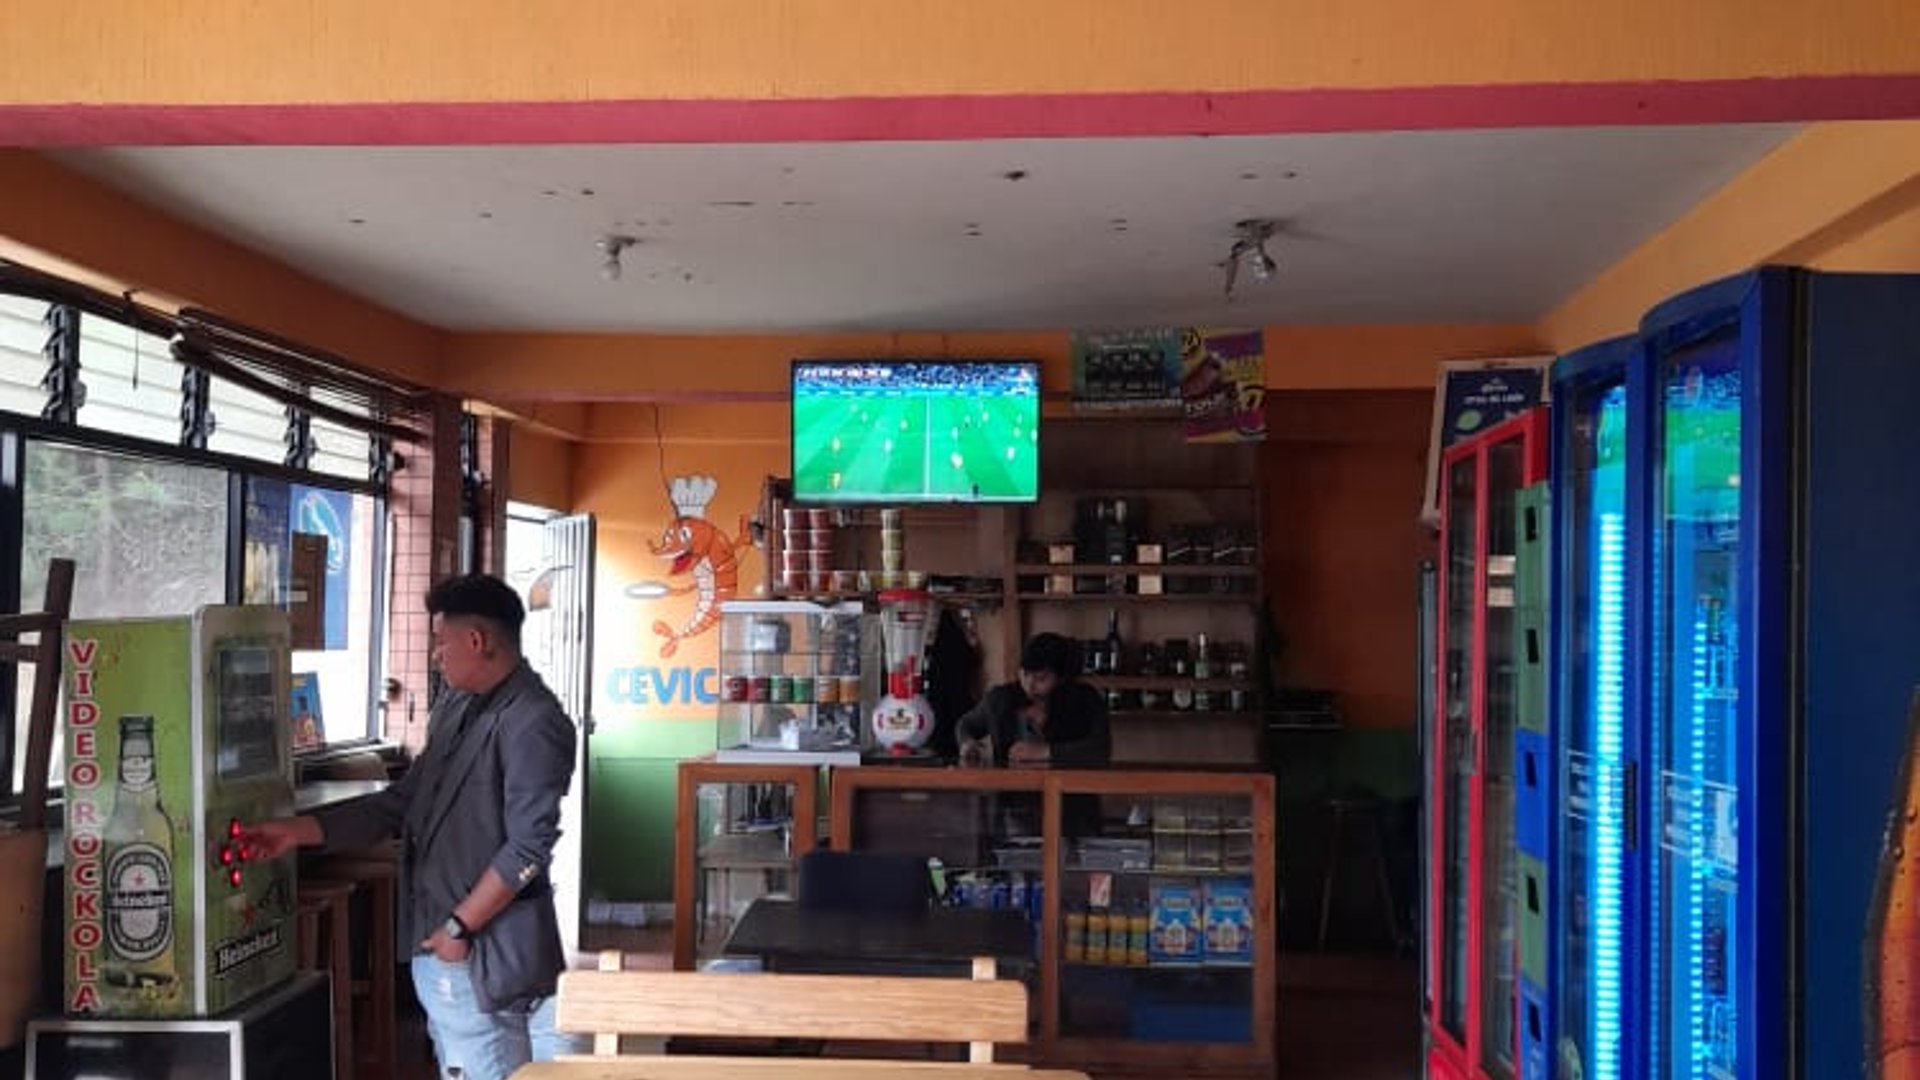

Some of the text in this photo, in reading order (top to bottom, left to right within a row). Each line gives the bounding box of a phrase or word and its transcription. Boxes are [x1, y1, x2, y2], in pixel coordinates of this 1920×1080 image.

[69, 638, 101, 1013] VIDEO ROCKOLA
[219, 930, 278, 972] Heineken
